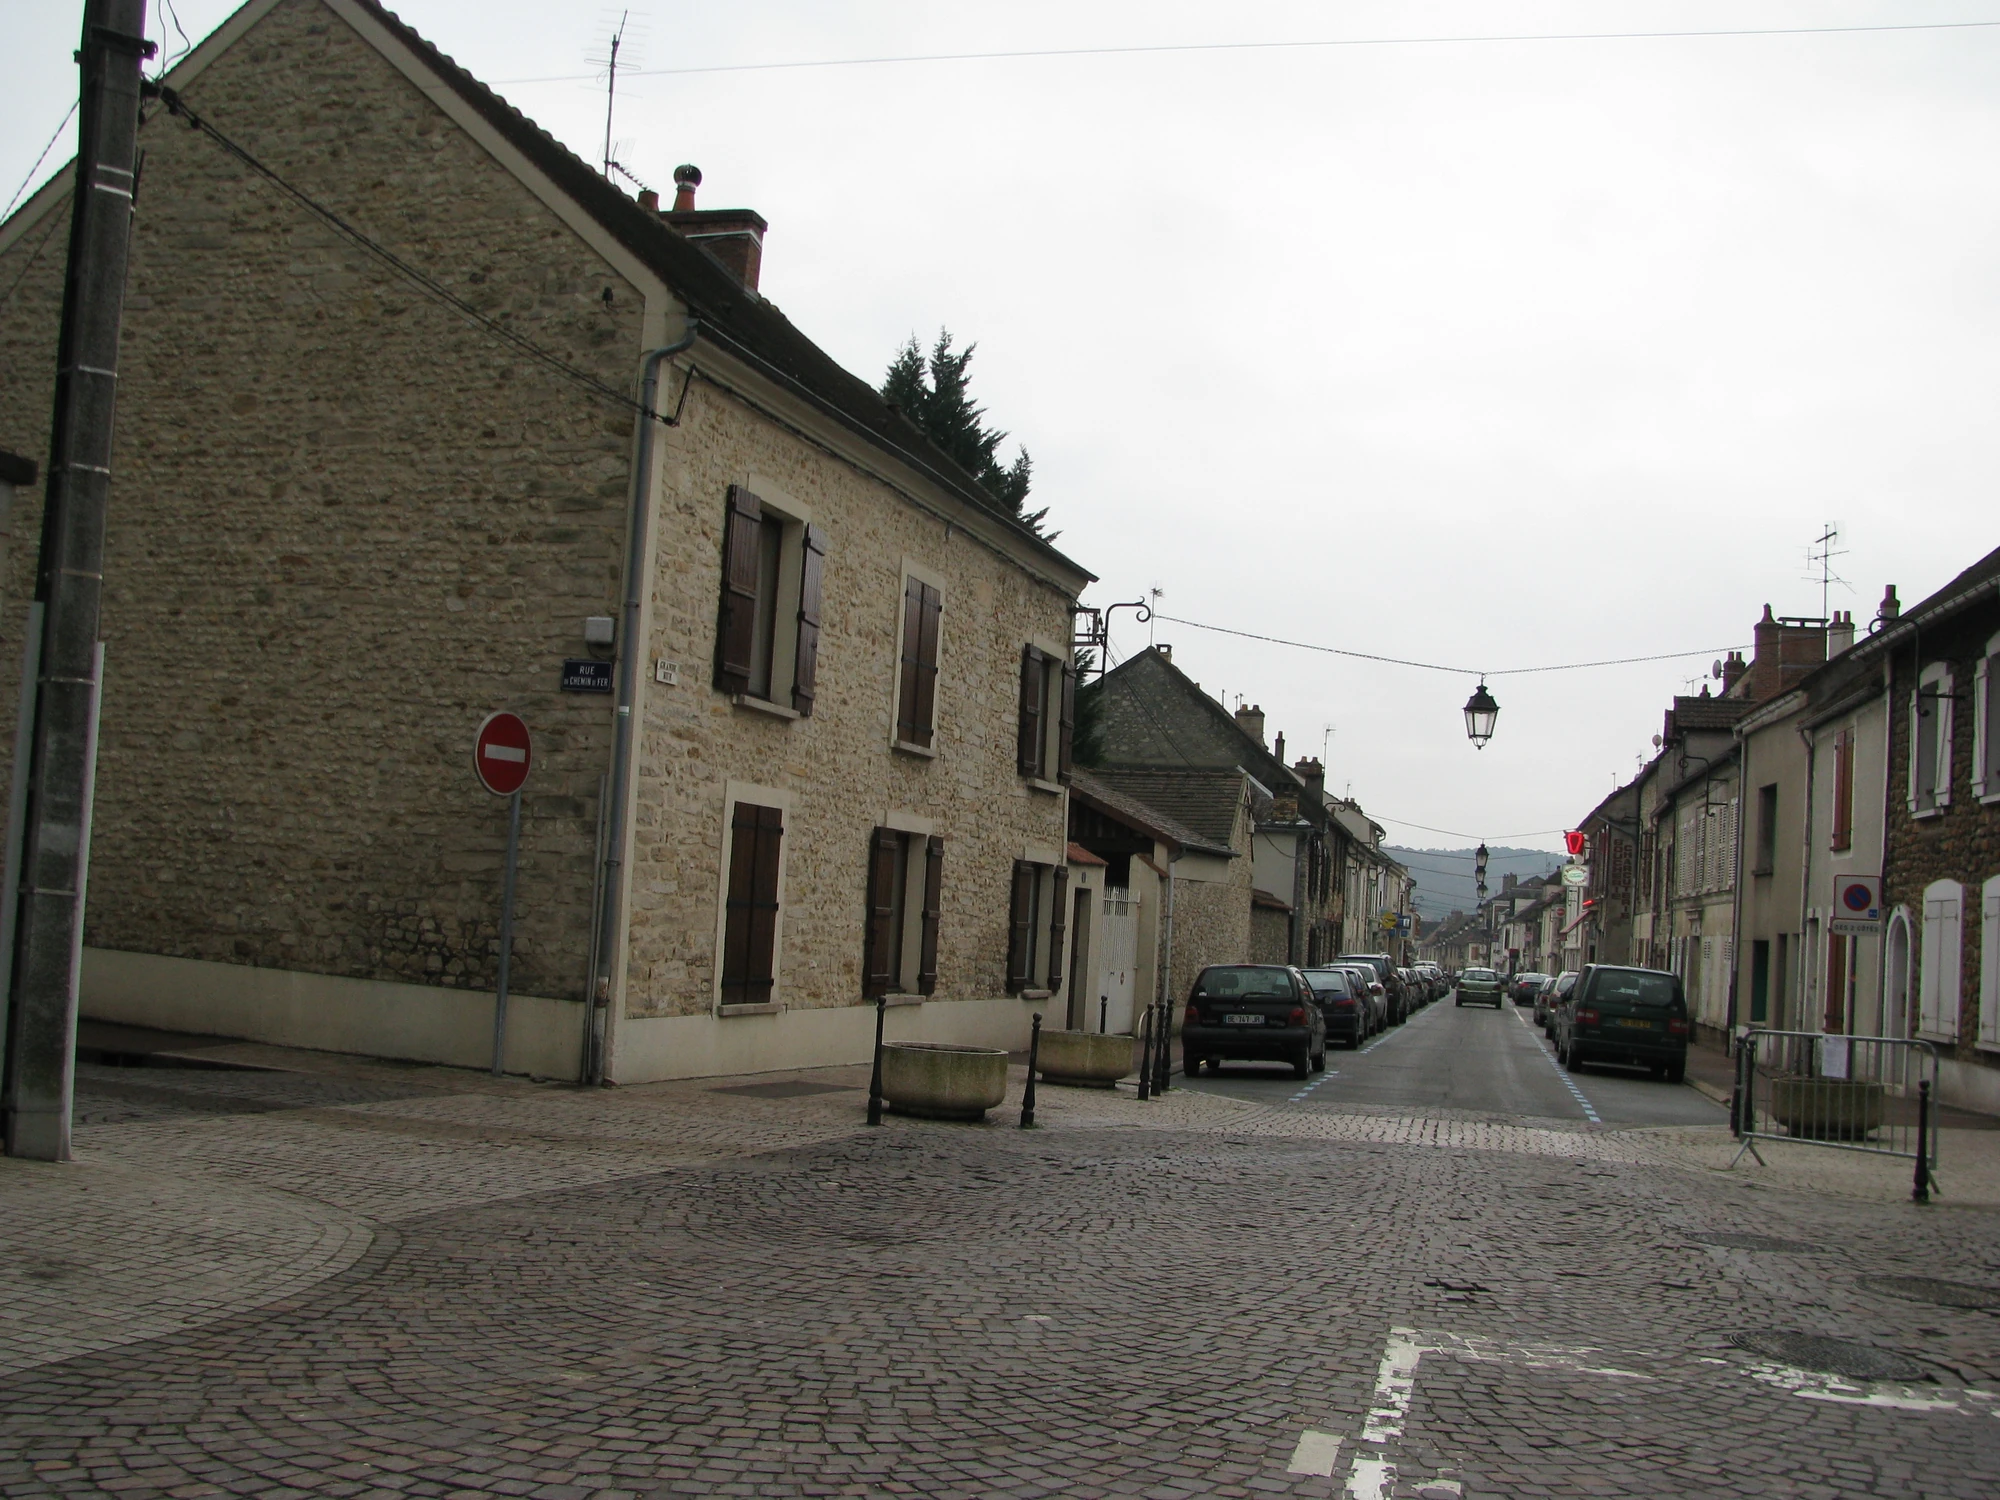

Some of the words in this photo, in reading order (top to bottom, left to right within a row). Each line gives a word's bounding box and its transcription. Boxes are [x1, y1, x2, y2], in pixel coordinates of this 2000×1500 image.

[569, 676, 591, 686] CHEMIN
[597, 677, 609, 687] FER
[579, 665, 595, 675] RUE
[1611, 838, 1623, 900] BOUCHERIE
[1620, 844, 1632, 919] CHARCUTERIE
